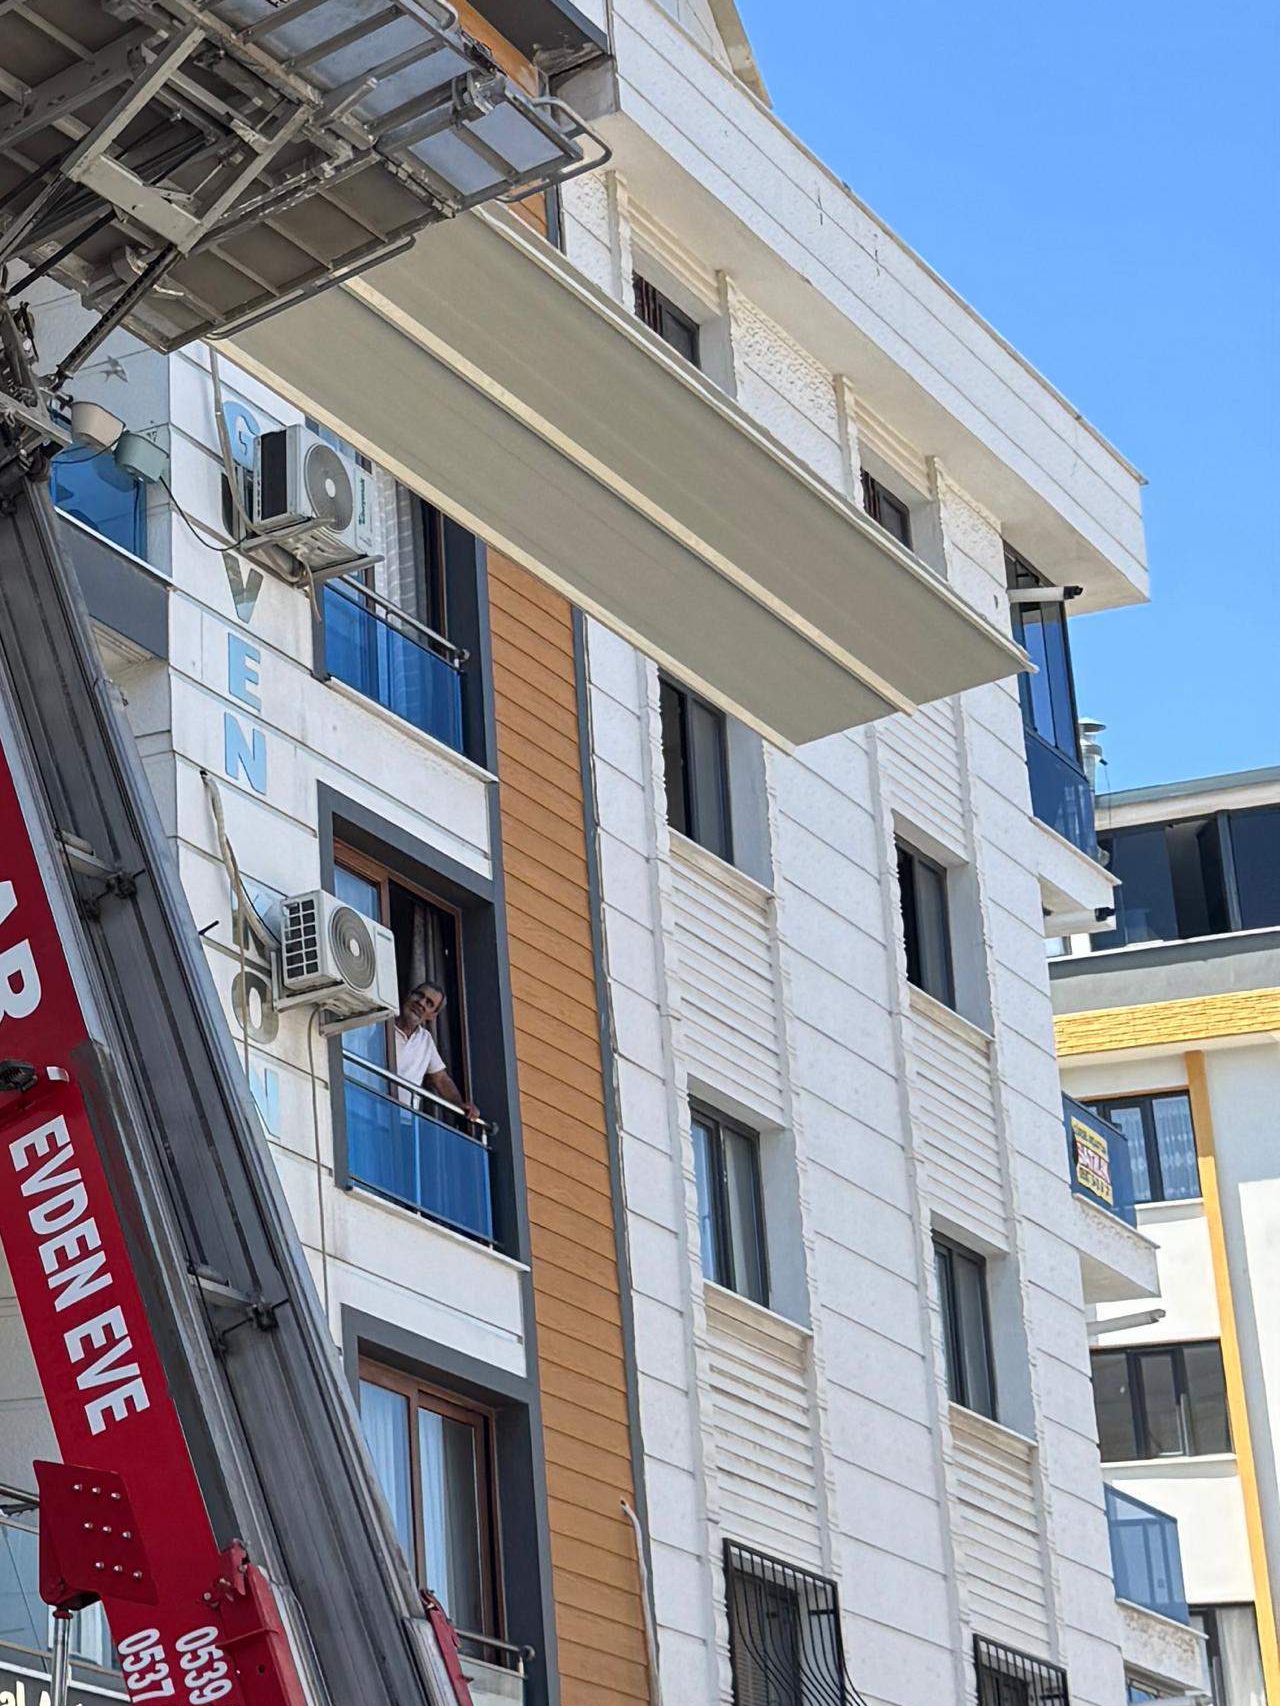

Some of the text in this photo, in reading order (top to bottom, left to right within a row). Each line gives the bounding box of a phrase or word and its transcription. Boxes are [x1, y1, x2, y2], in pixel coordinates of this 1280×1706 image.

[8, 1114, 150, 1436] EVDEN EVE
[117, 1628, 175, 1703] 0537
[175, 1626, 232, 1706] 0539
